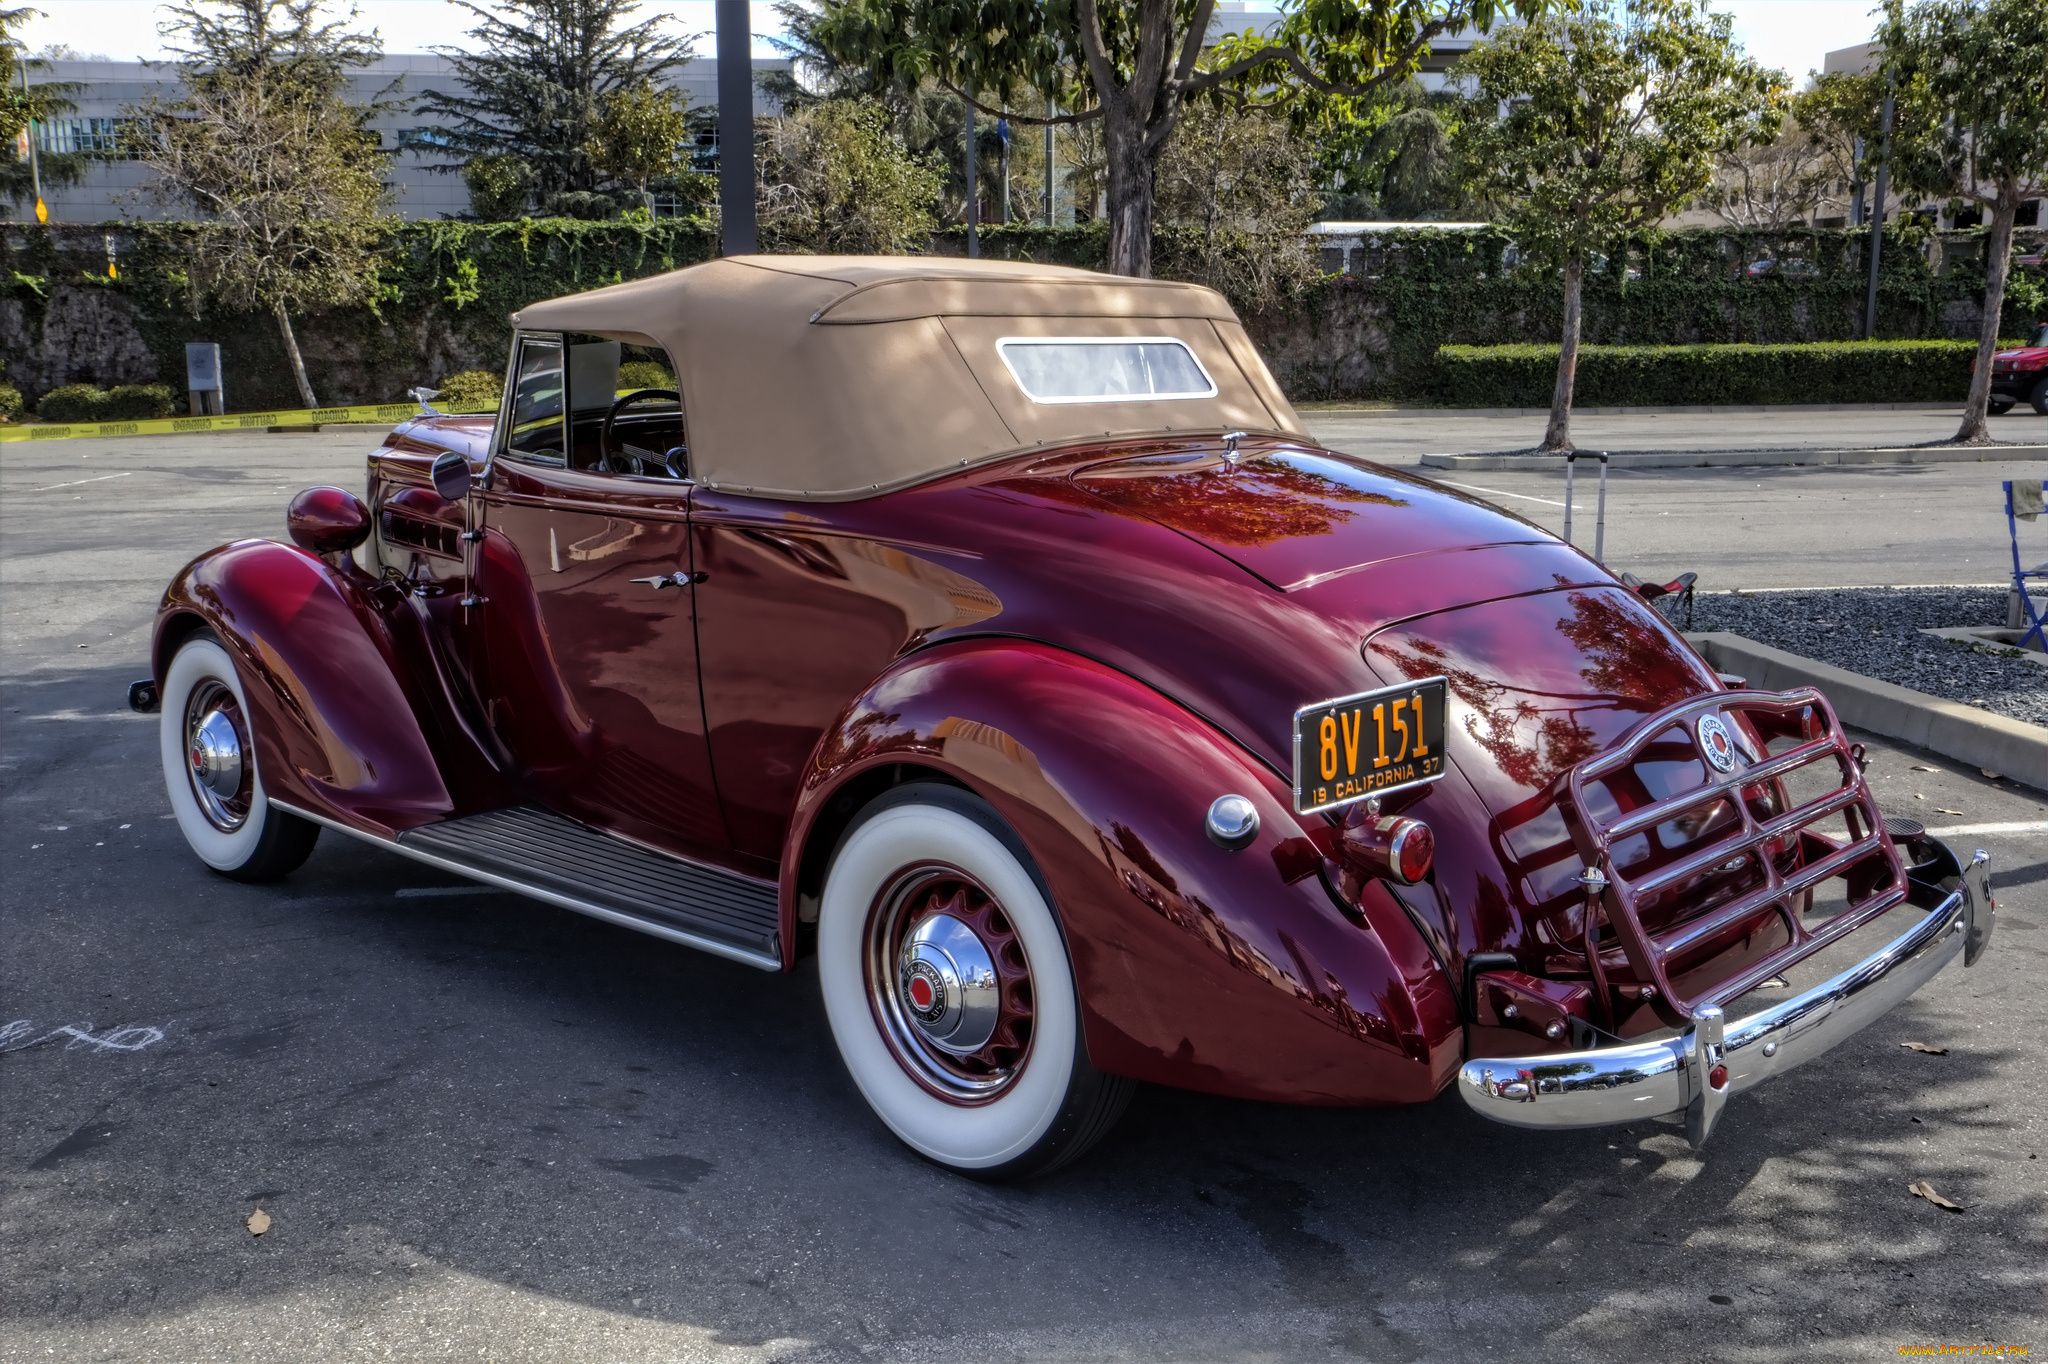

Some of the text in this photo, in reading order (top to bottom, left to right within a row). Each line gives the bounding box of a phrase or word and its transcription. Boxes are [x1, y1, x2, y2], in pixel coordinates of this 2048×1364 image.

[1320, 695, 1429, 781] 8V 151
[1312, 757, 1439, 805] 19 CALIFORNIA 37
[917, 964, 944, 1017] PACKARD SIX
